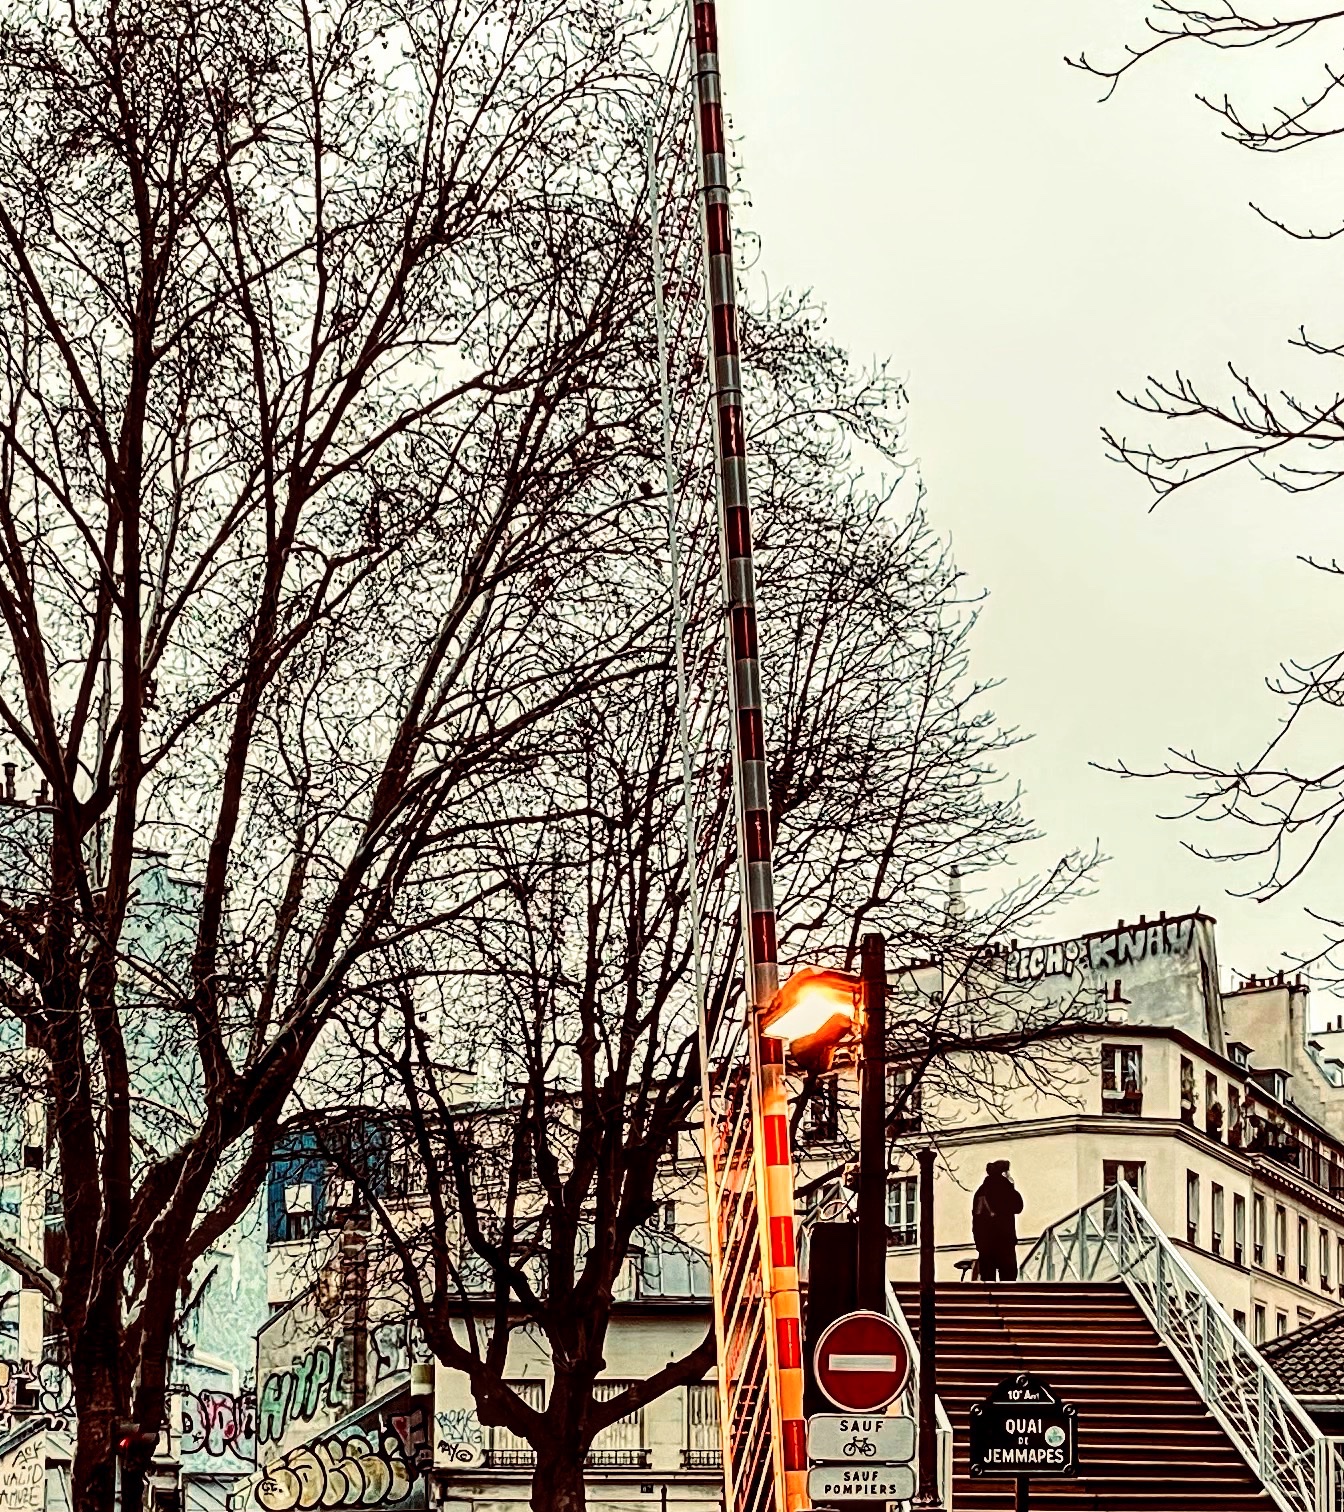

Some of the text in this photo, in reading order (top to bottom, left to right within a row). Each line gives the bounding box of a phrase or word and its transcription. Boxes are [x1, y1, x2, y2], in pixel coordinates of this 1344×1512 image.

[839, 1419, 884, 1432] SAUF
[1005, 1418, 1042, 1434] QUAI
[983, 1448, 1064, 1464] JEMMAPES
[843, 1470, 879, 1482] SAUF
[824, 1484, 897, 1495] POMPIERS
